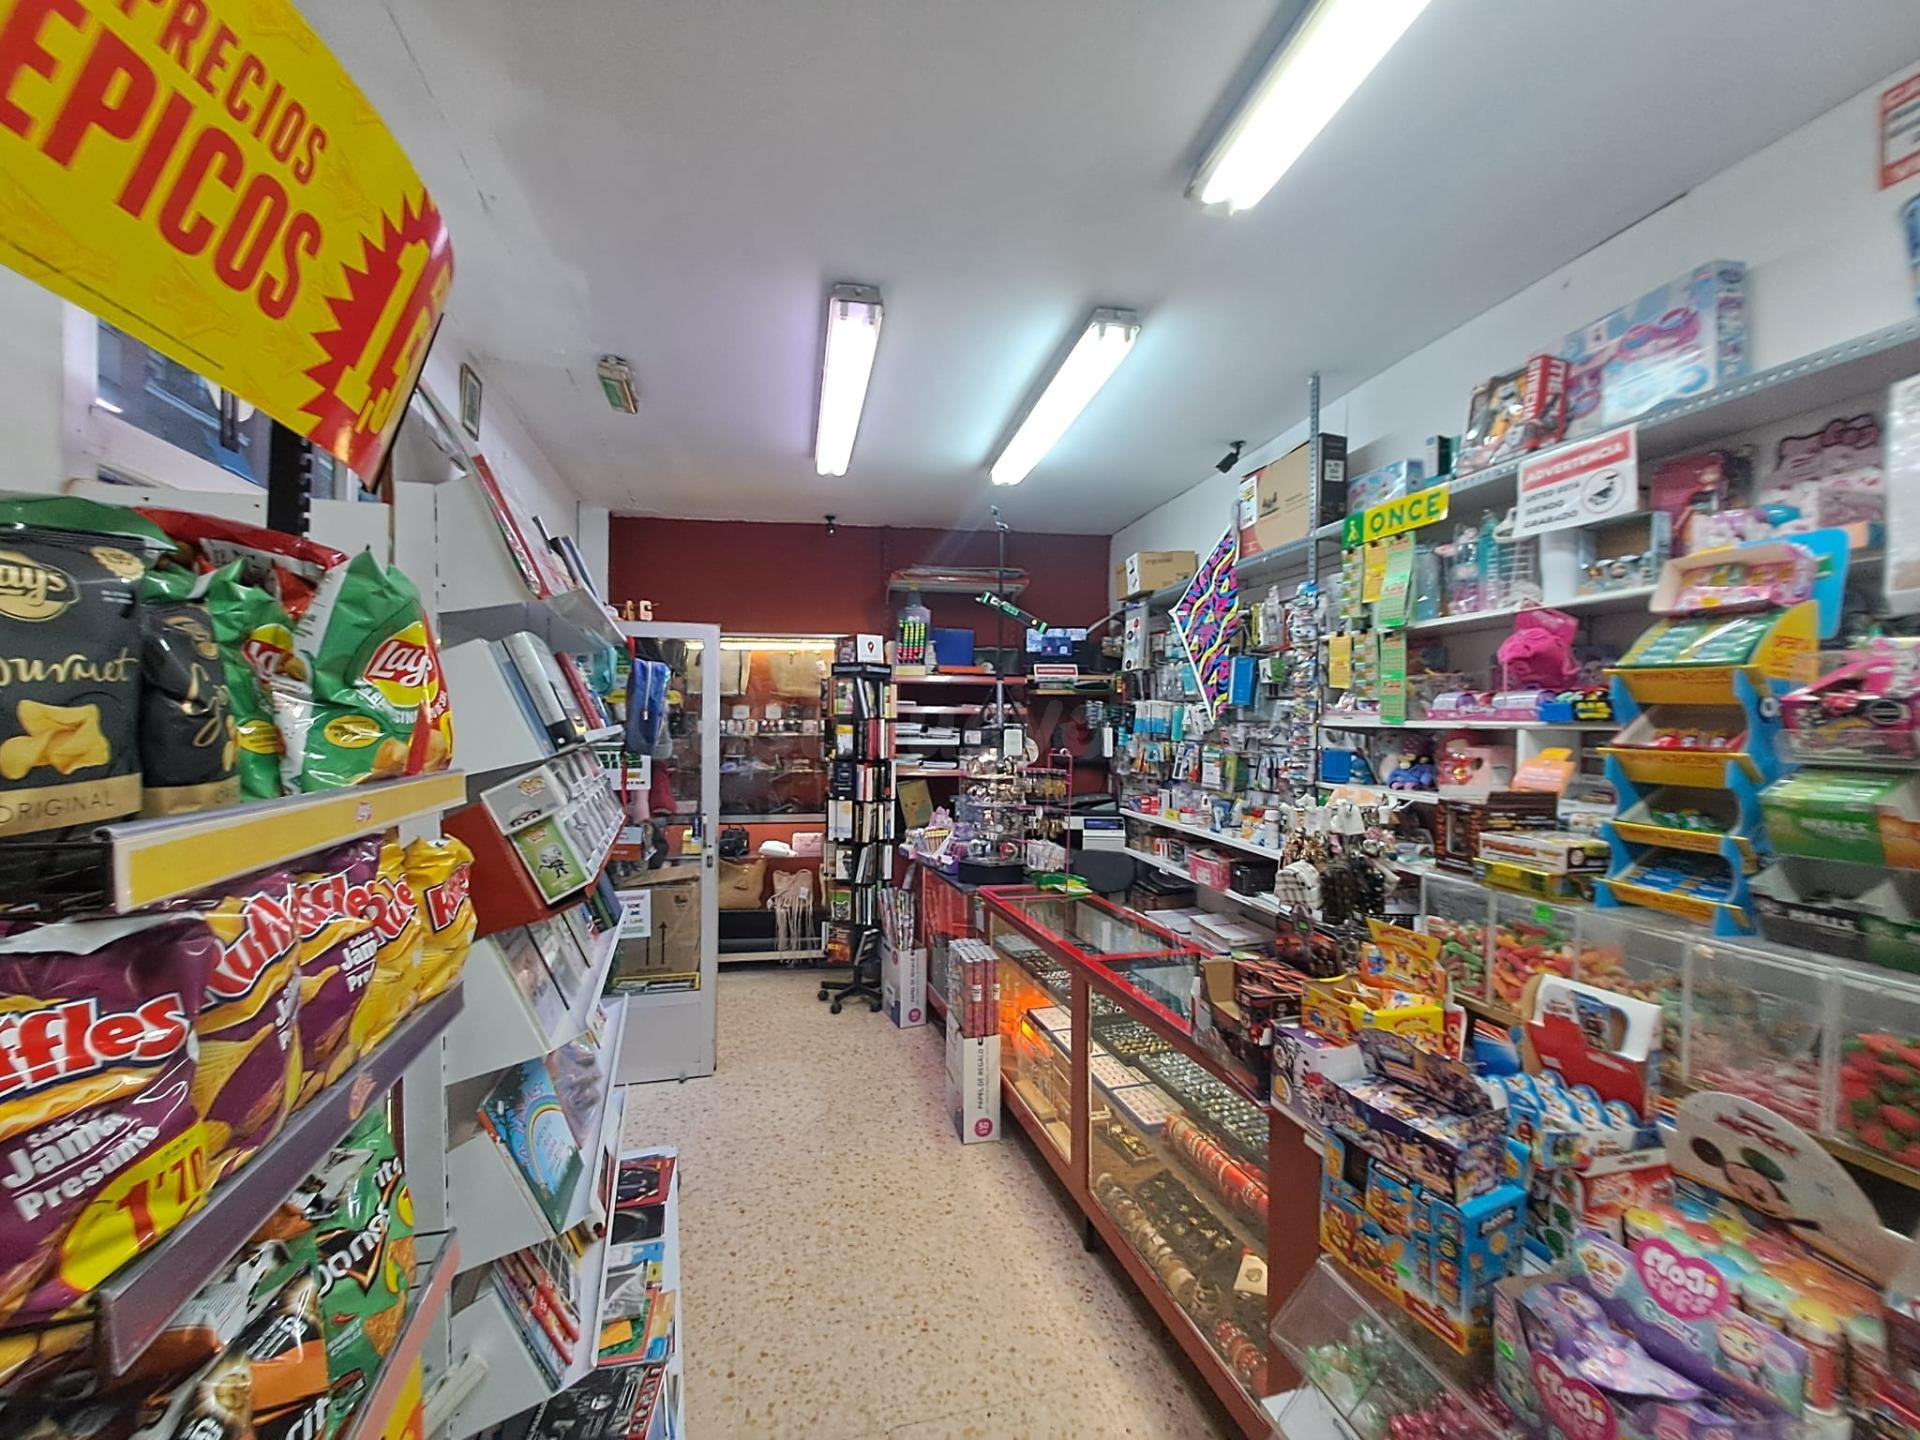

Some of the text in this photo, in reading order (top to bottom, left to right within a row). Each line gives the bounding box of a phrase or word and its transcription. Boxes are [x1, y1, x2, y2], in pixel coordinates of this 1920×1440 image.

[0, 0, 322, 320] EPICOS
[1370, 493, 1441, 533] ONCE
[0, 646, 139, 686] ourmet
[0, 993, 188, 1093] ffles
